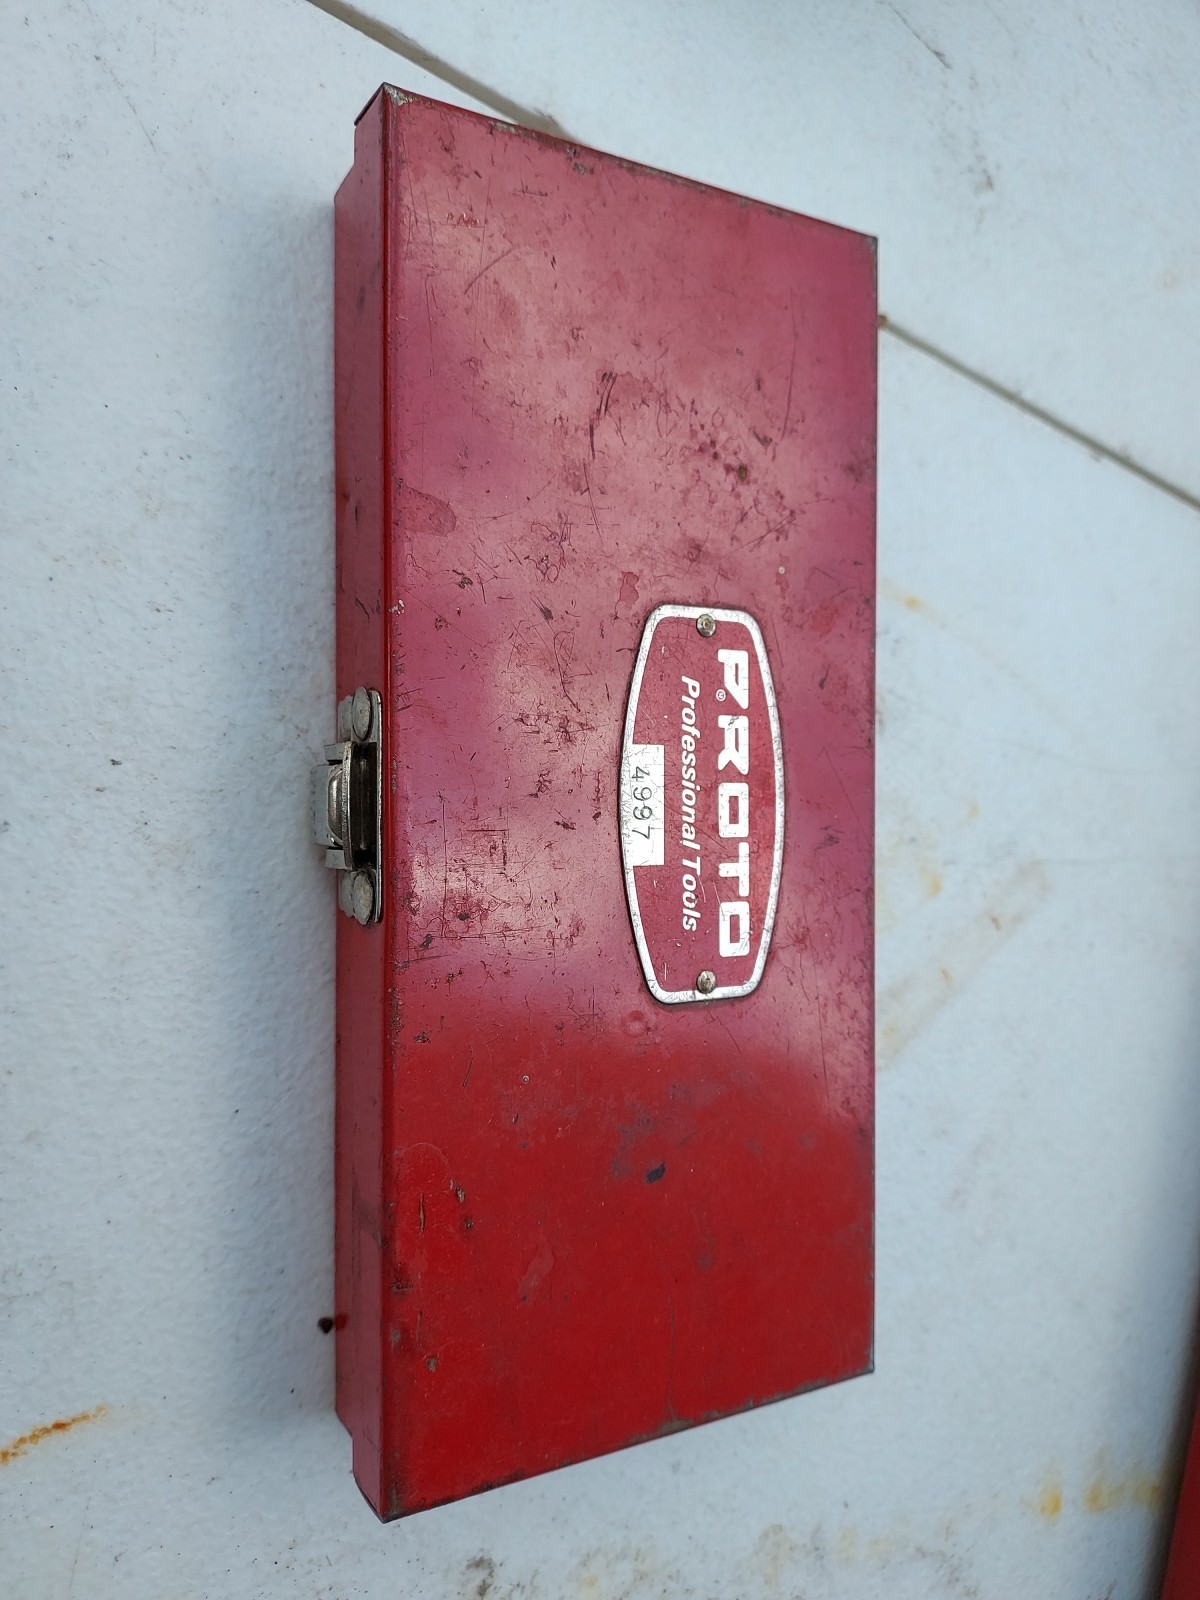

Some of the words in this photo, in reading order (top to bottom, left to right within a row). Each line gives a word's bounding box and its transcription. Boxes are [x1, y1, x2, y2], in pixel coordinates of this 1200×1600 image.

[631, 766, 653, 841] 4997
[680, 676, 701, 849] Professional
[717, 648, 751, 958] PROTO
[681, 857, 701, 932] Tools
